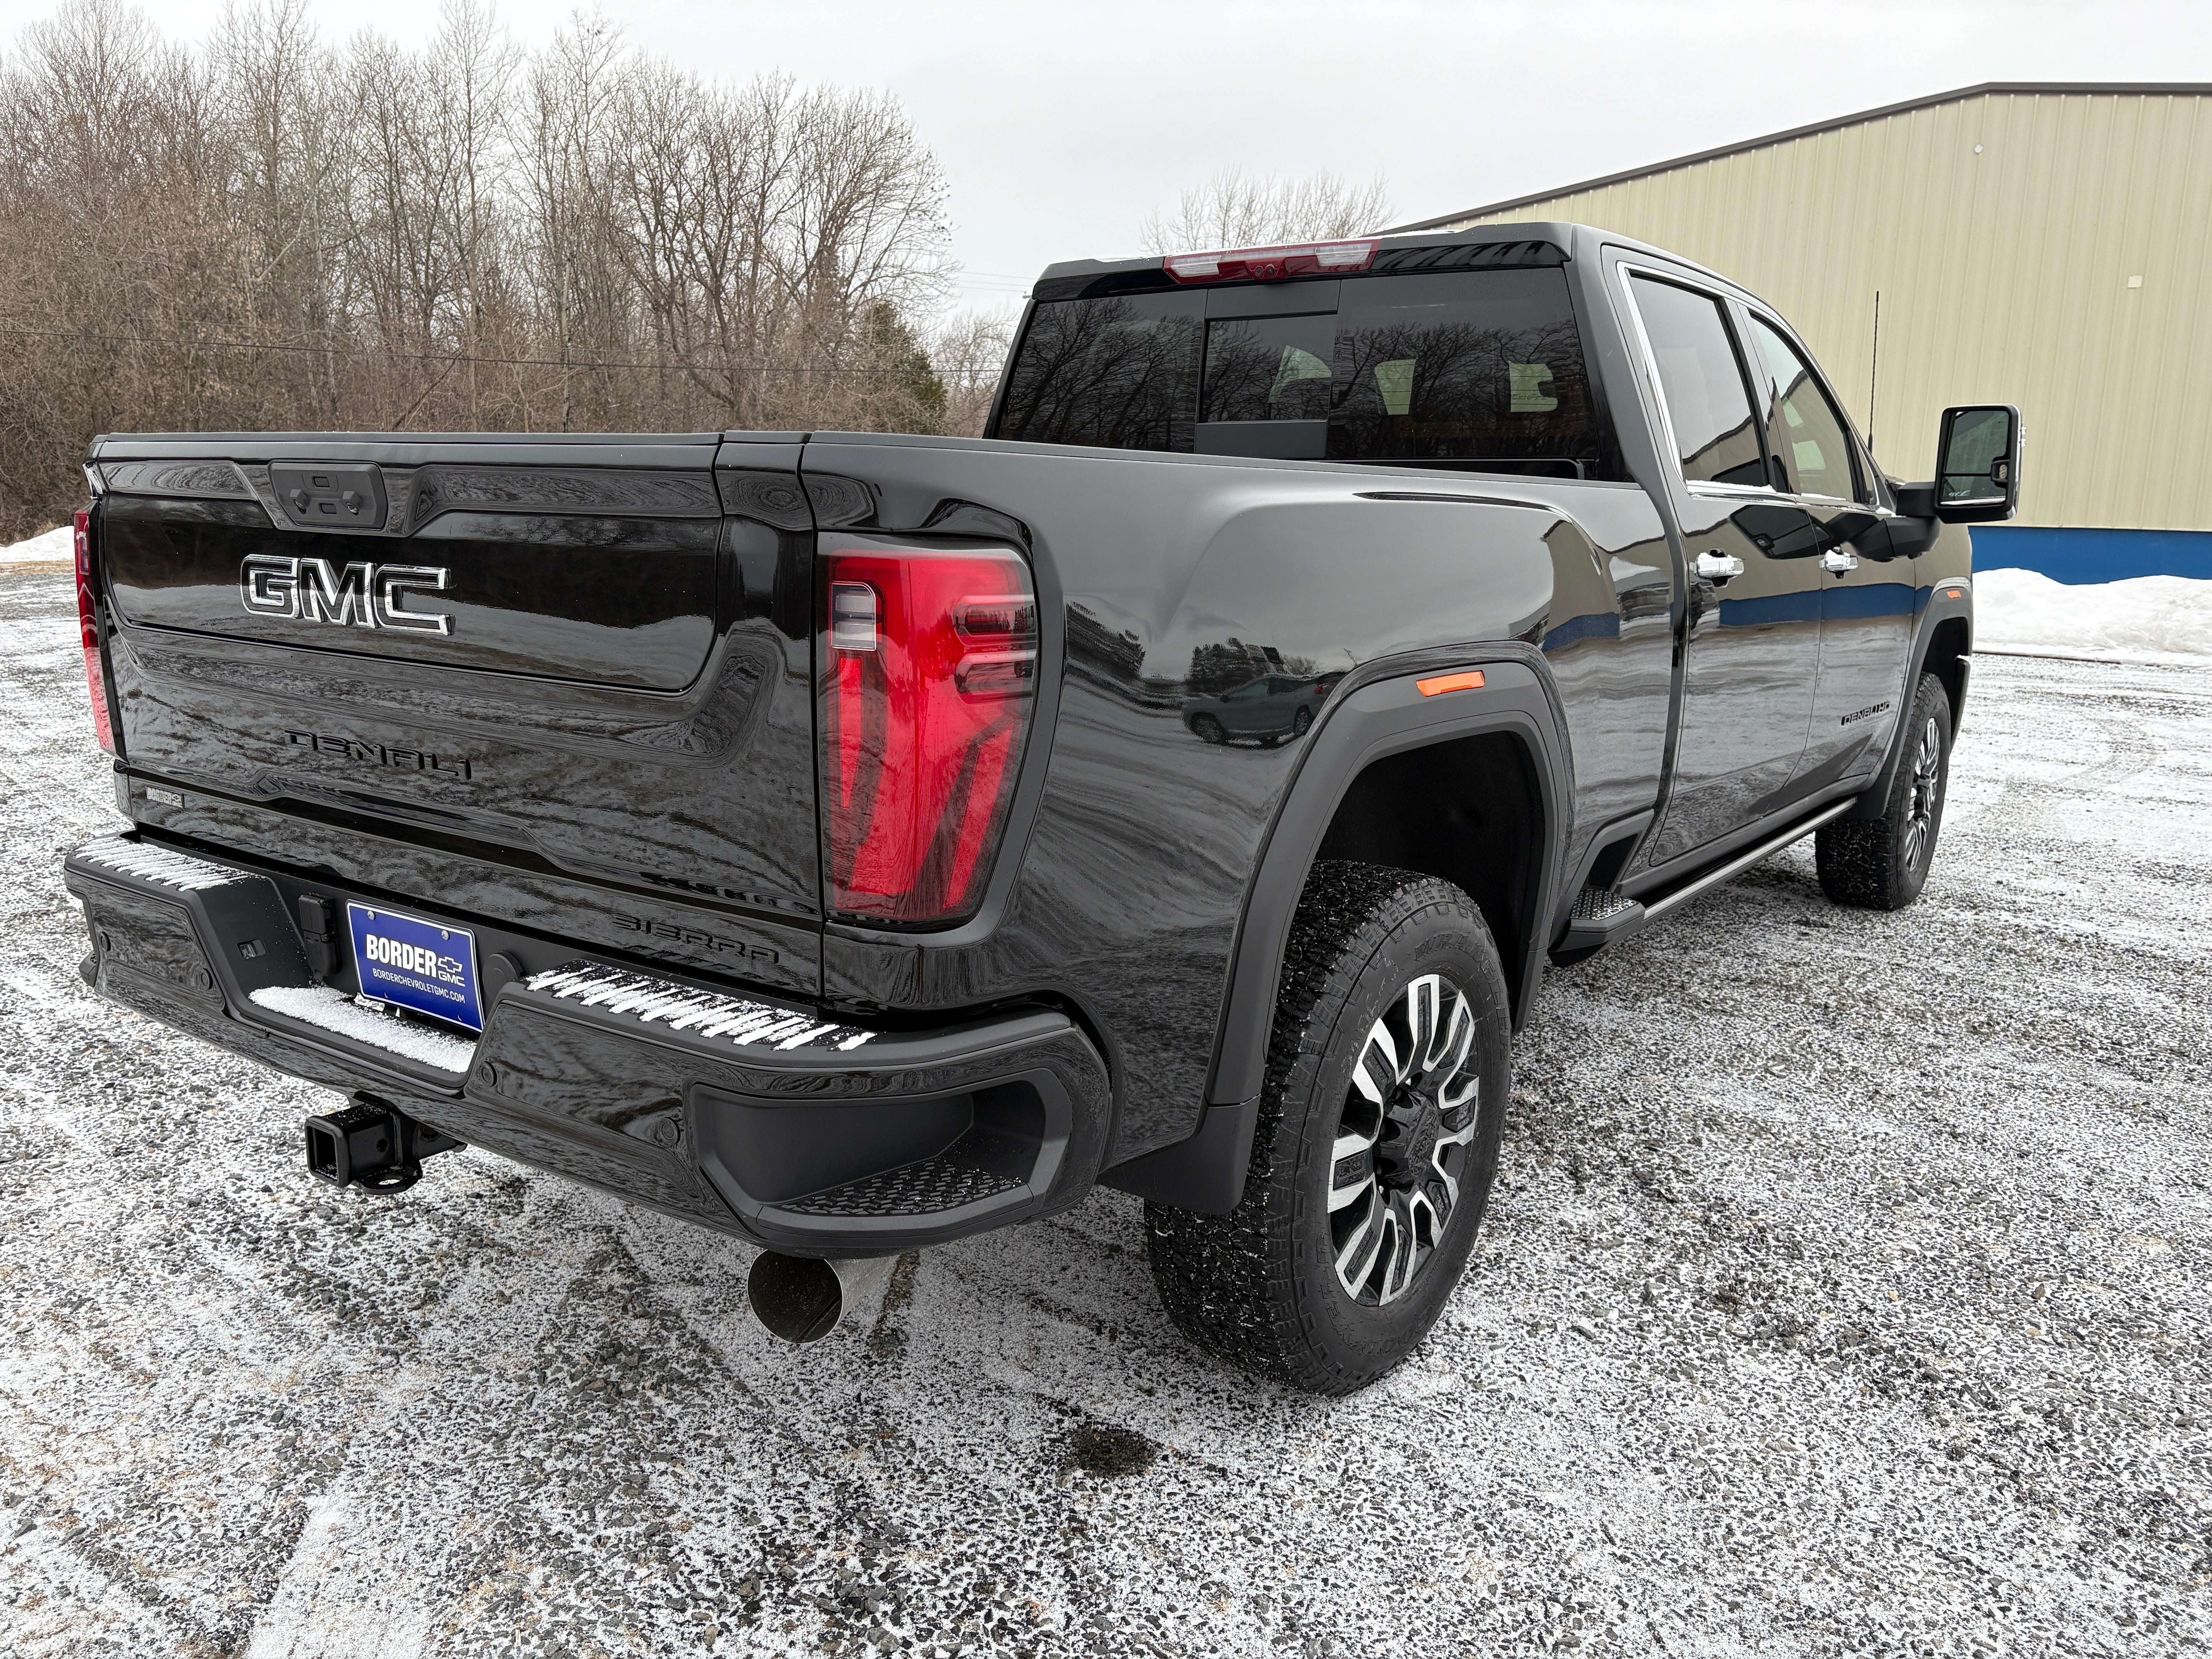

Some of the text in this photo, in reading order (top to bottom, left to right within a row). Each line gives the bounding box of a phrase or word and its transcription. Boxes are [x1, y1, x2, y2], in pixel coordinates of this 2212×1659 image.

[240, 554, 455, 636] GMC
[285, 728, 471, 780] DENALI
[366, 934, 437, 977] BORDER
[612, 913, 779, 964] SIERRA
[372, 968, 465, 1004] BORDERCHEVROLETGMC.COM
[438, 970, 465, 987] GMC
